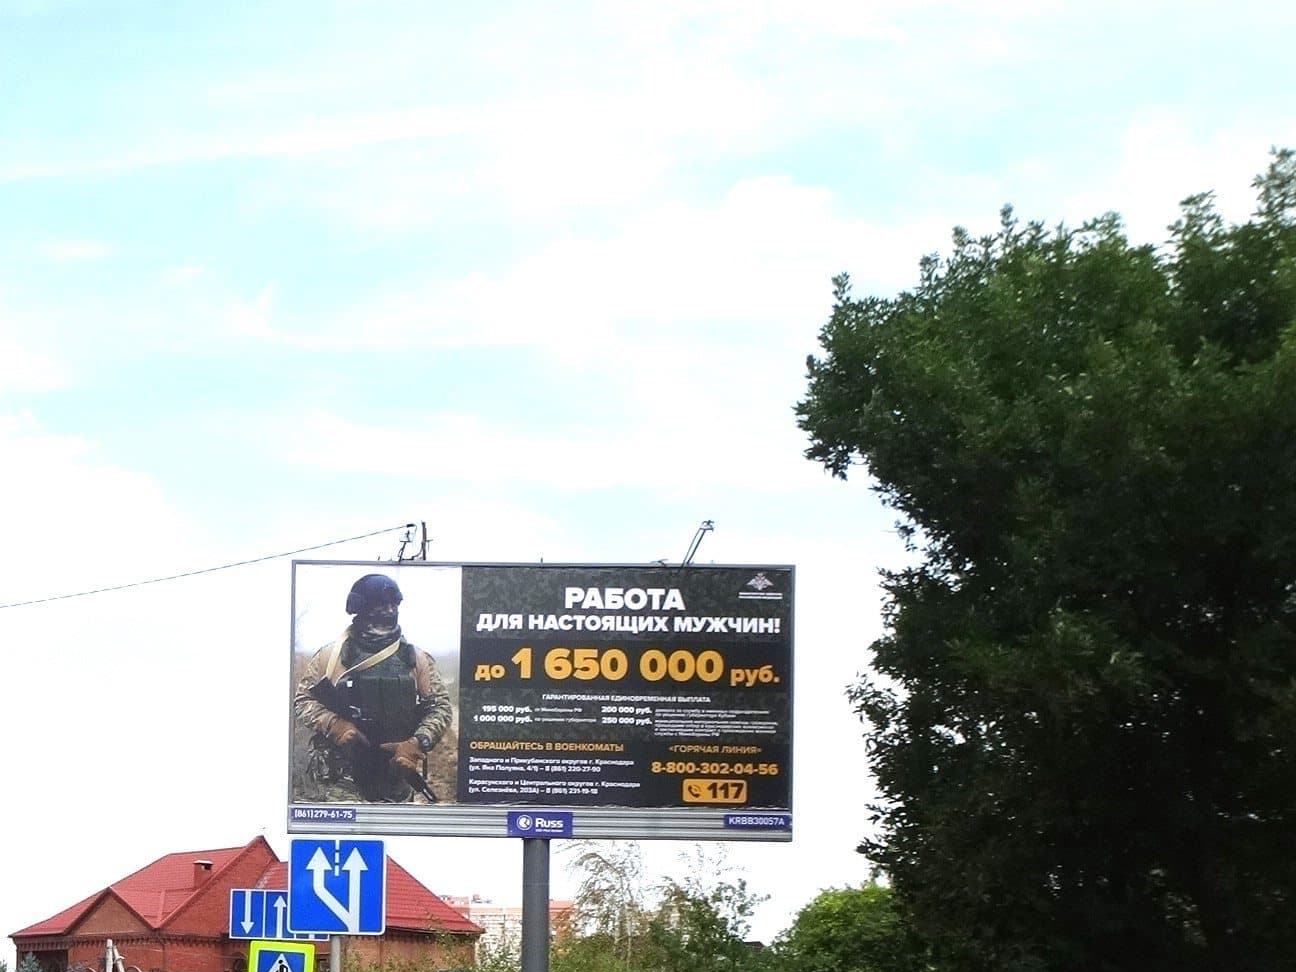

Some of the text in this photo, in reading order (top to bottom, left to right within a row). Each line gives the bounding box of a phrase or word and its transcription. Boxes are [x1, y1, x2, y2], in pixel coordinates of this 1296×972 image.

[565, 587, 686, 610] РАБОТА
[476, 613, 781, 634] ДЛЯ НАСТОЯЩИХ МУЖЧИН!
[474, 647, 780, 687] до 1 650 000 руб.
[542, 693, 610, 701] ГАРАНТИРОВАННАЯ
[515, 706, 532, 714] руб.
[635, 706, 652, 715] руб.
[515, 716, 533, 724] руб.
[635, 717, 653, 726] руб.
[469, 740, 624, 752] ОБРАЩАЙТЕСЬ В ВОЕНКОМАТЫ
[668, 744, 762, 754] «ГОРЯЧАЯ ЛИНИЯ»
[651, 761, 779, 775] 8-800-302-04-56
[706, 782, 745, 799] 117
[535, 817, 564, 828] Russ
[728, 816, 785, 826] KRBB30057A
